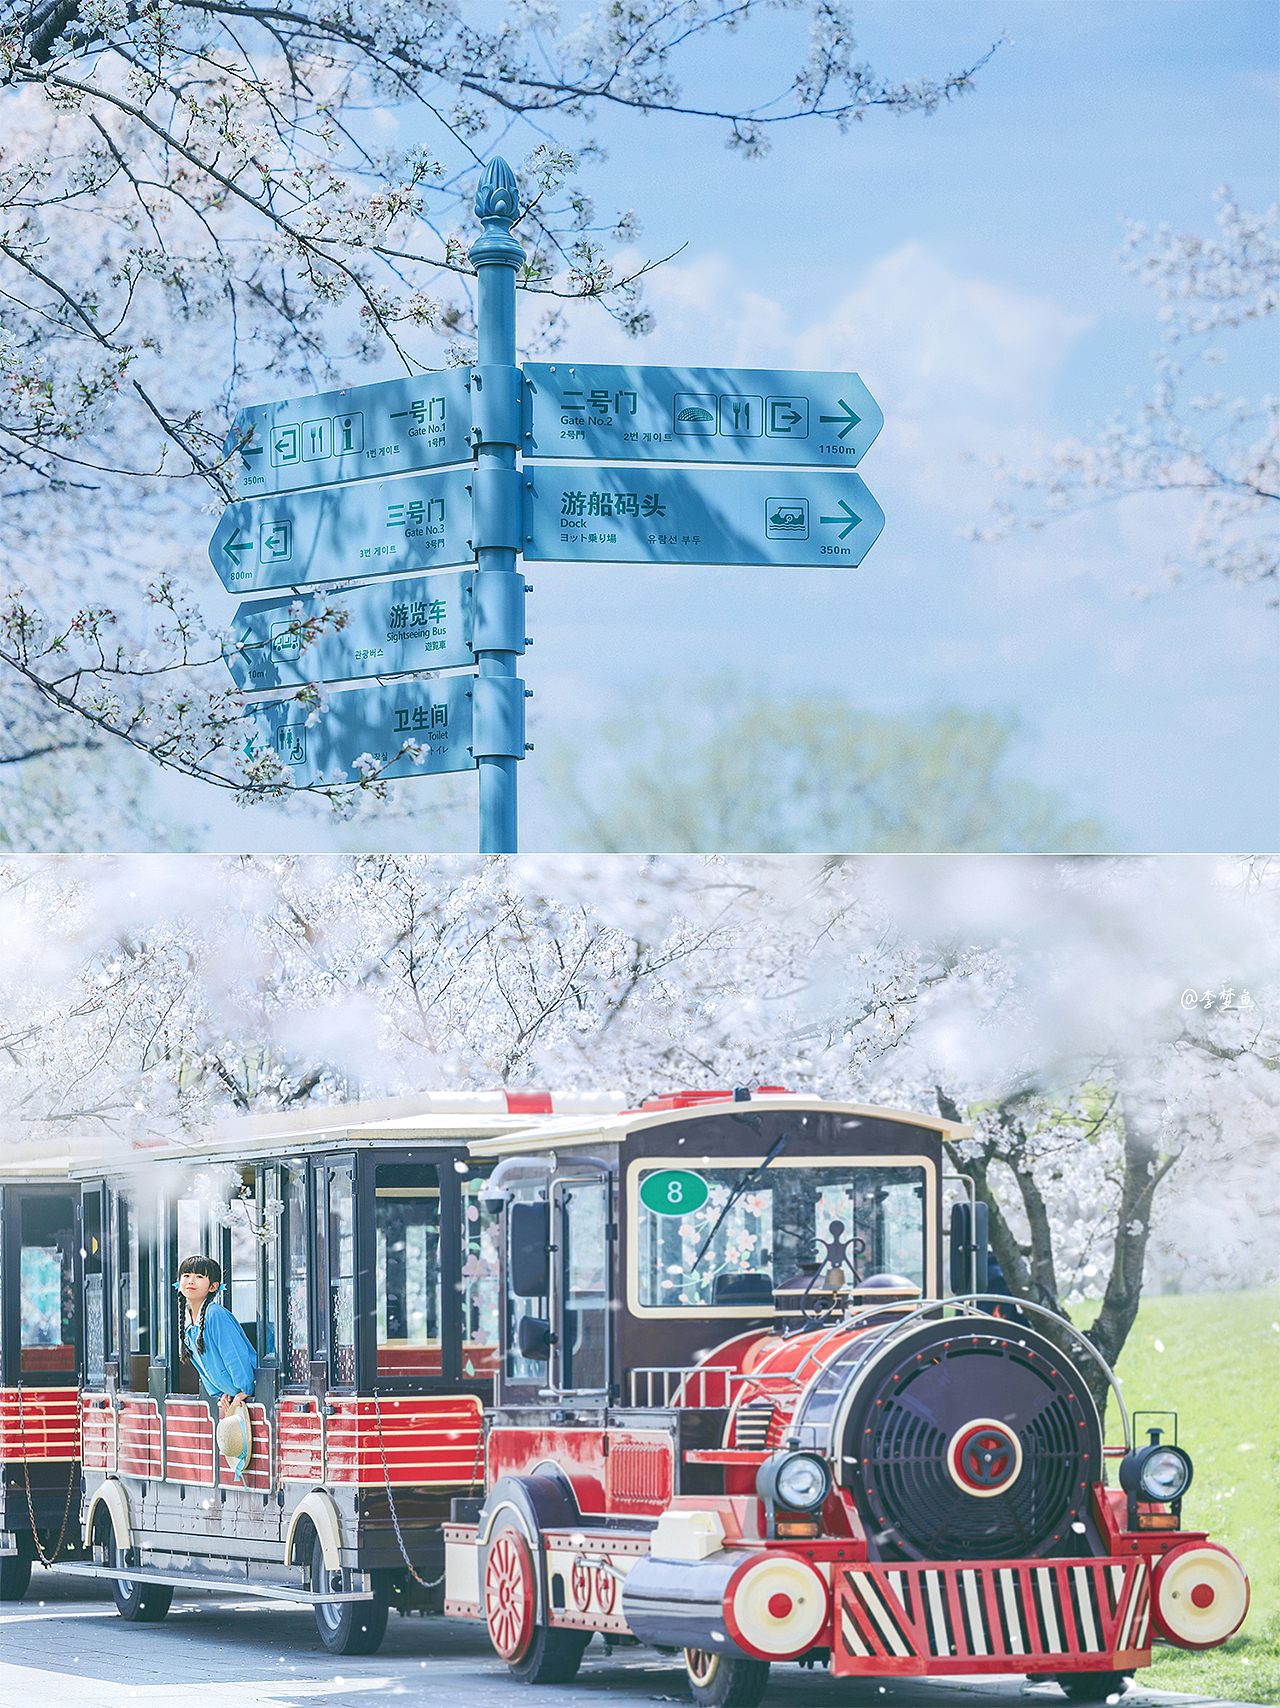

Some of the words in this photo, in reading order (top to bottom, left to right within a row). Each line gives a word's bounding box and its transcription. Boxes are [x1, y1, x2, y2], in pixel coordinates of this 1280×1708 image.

[560, 390, 638, 415] 二号门
[389, 397, 446, 424] 一号门
[560, 416, 585, 426] Gate
[588, 416, 613, 426] No.2
[408, 427, 426, 438] Gate
[428, 424, 446, 435] No.1
[623, 432, 639, 441] 2번
[643, 432, 673, 442] 게이트
[366, 449, 377, 459] 1번
[378, 444, 401, 457] 게이트
[819, 445, 856, 455] 1150m
[243, 475, 265, 486] 350m
[560, 491, 666, 518] 游船码头
[386, 498, 445, 527] 三号门
[560, 518, 587, 528] Dock
[405, 527, 424, 538] Gate
[425, 524, 445, 535] No.3
[560, 533, 617, 544] ヨット乗り場
[681, 535, 701, 545] 부두
[359, 548, 371, 558] 3번
[373, 544, 397, 557] 게이트
[820, 545, 851, 555] 350m
[230, 570, 253, 581] 800m
[389, 599, 447, 629] 游览车
[386, 629, 430, 643] Sightseeing
[432, 626, 447, 637] Bus
[354, 648, 384, 660] 관광버스
[248, 670, 264, 679] 10m
[393, 703, 448, 733] 卫生间
[428, 731, 449, 741] Toilet
[667, 1181, 683, 1203] 8
